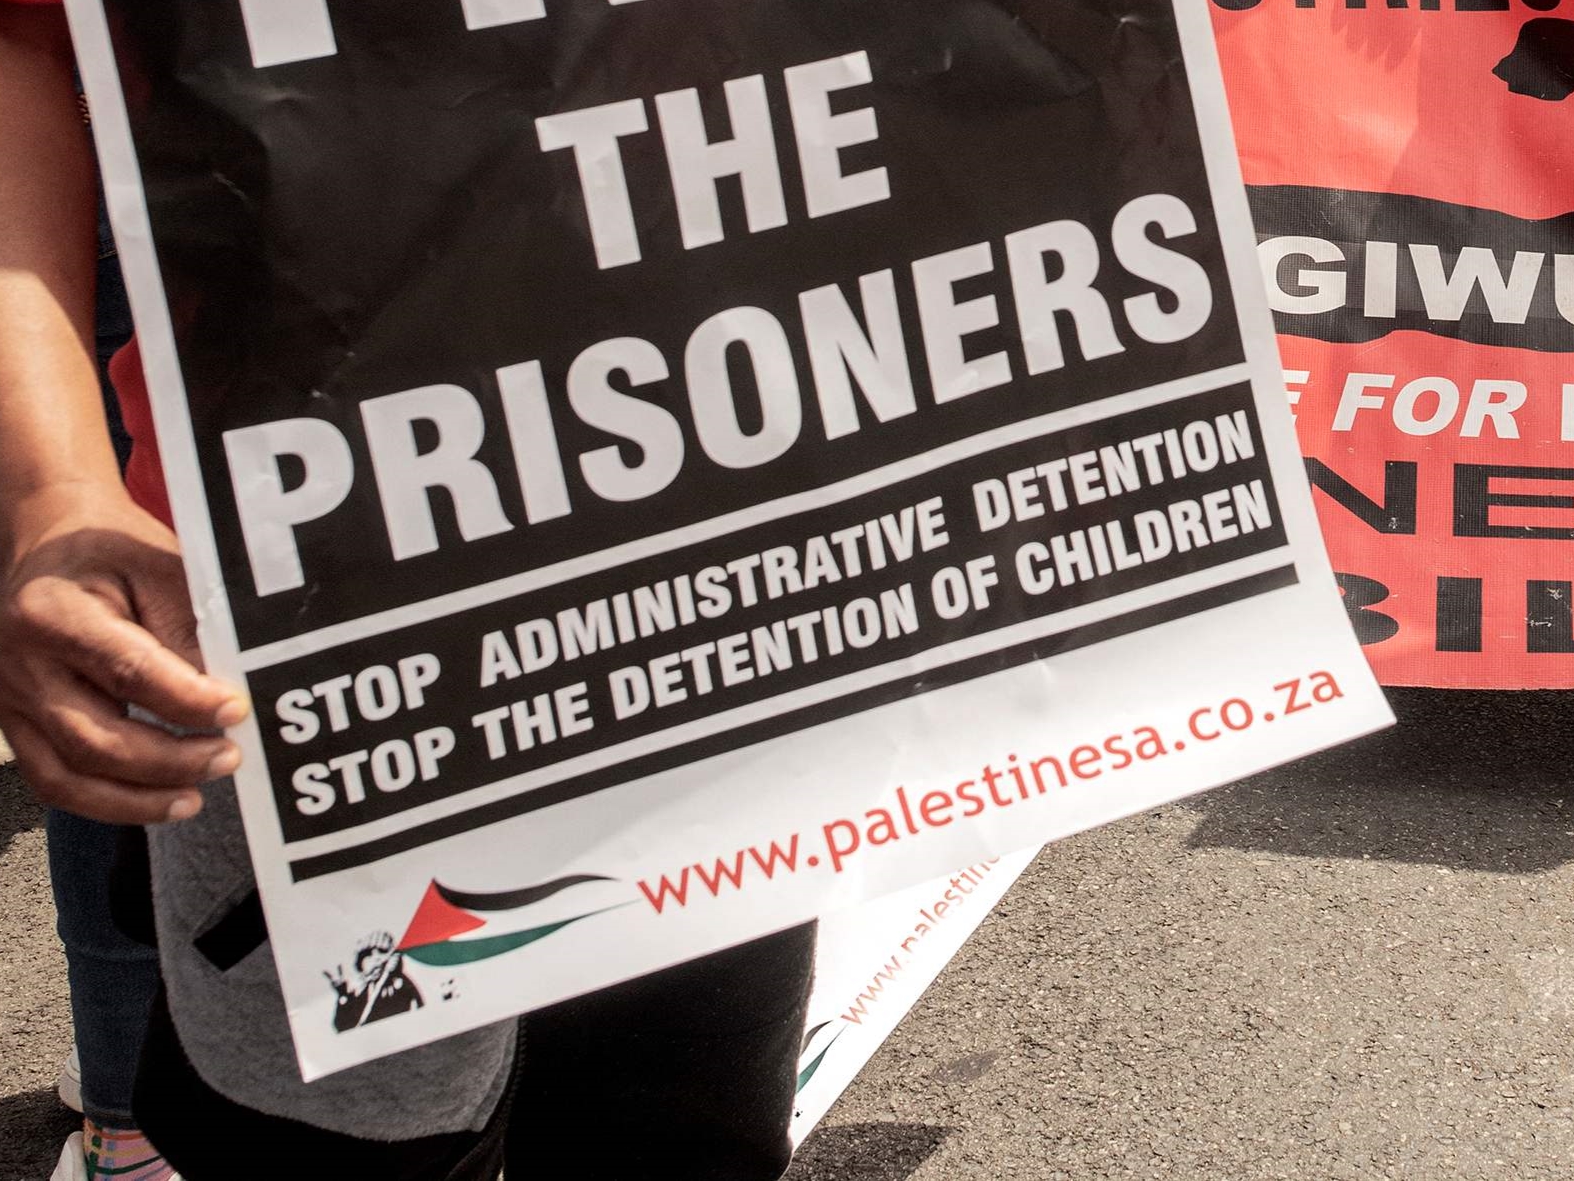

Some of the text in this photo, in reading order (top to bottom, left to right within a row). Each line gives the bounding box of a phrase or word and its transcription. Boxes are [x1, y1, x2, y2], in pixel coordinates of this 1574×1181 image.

[536, 50, 891, 270] THE
[221, 193, 1214, 599] PRISONERS
[1331, 372, 1527, 439] FOR
[275, 409, 1256, 745] STOP ADMINISTRATIVE DETENTION
[290, 479, 1272, 817] STOP THE DETENTION OF CHILDREN
[637, 665, 1344, 915] www.palestinesa.co.za
